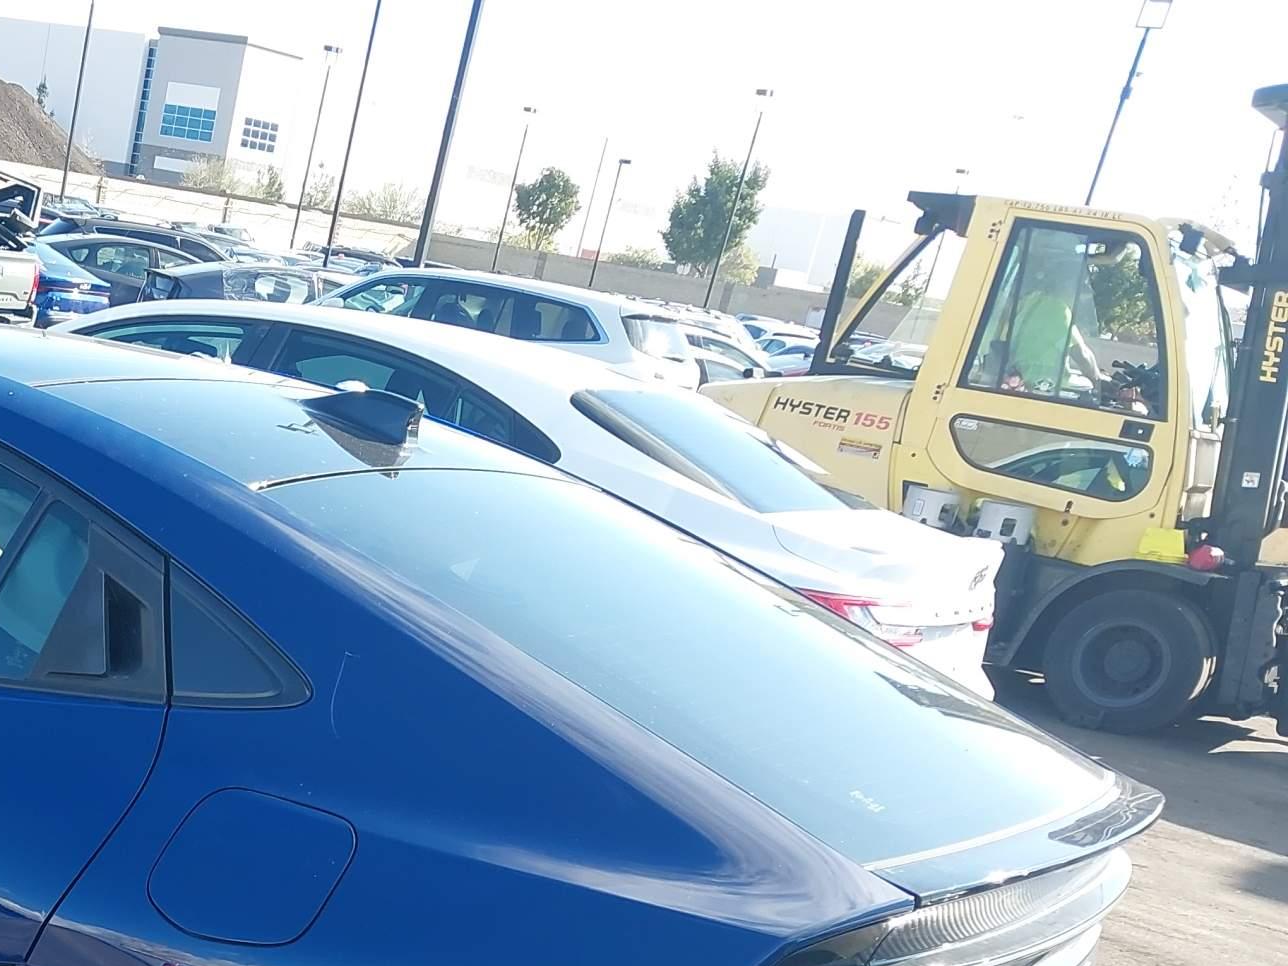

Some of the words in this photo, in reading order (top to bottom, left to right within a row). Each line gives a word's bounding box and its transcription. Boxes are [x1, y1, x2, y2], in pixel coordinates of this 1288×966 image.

[773, 396, 851, 423] HYSTER
[853, 412, 892, 430] 155
[812, 420, 846, 432] FORTIS
